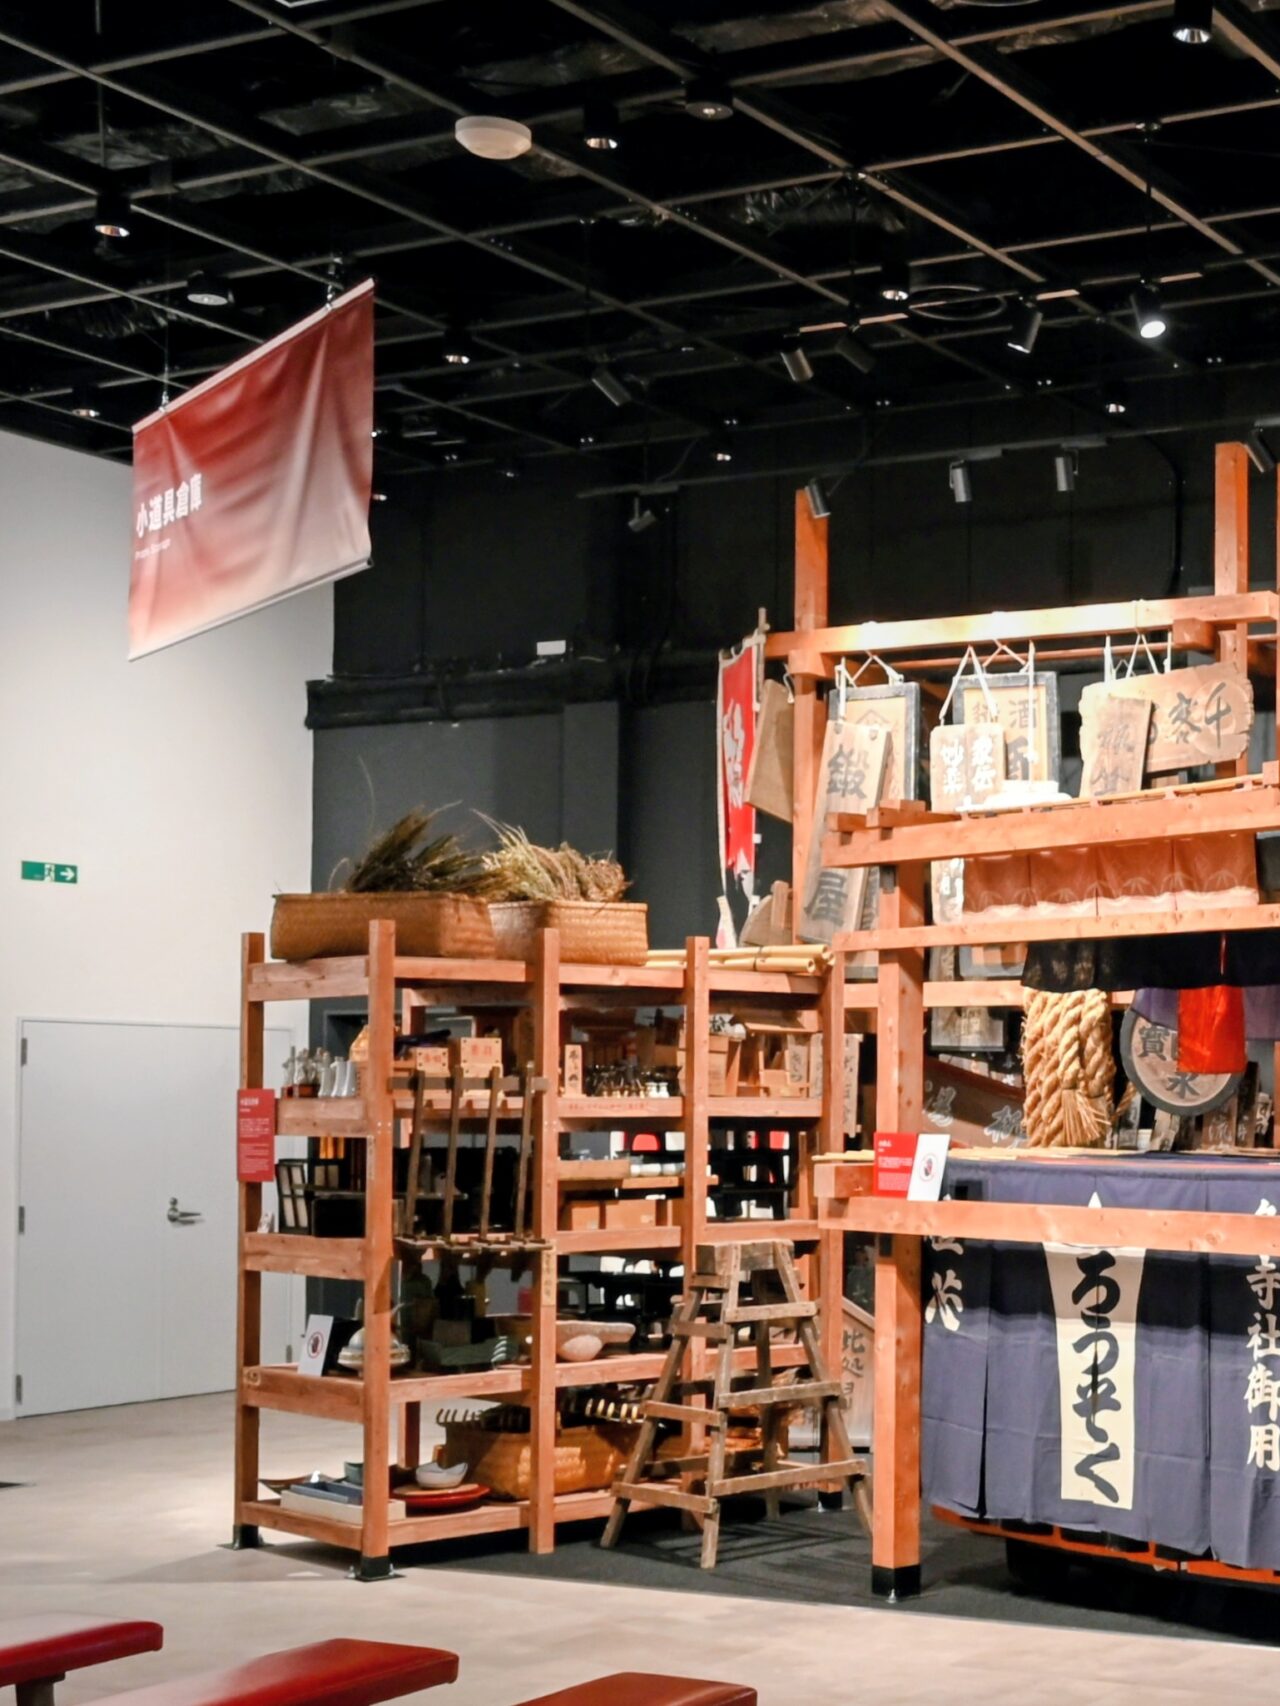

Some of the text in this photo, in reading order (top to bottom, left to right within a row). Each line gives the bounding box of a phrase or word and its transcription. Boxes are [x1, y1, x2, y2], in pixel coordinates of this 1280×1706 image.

[136, 473, 202, 538] 小道具倉庫
[1071, 1250, 1124, 1504] ろうそく
